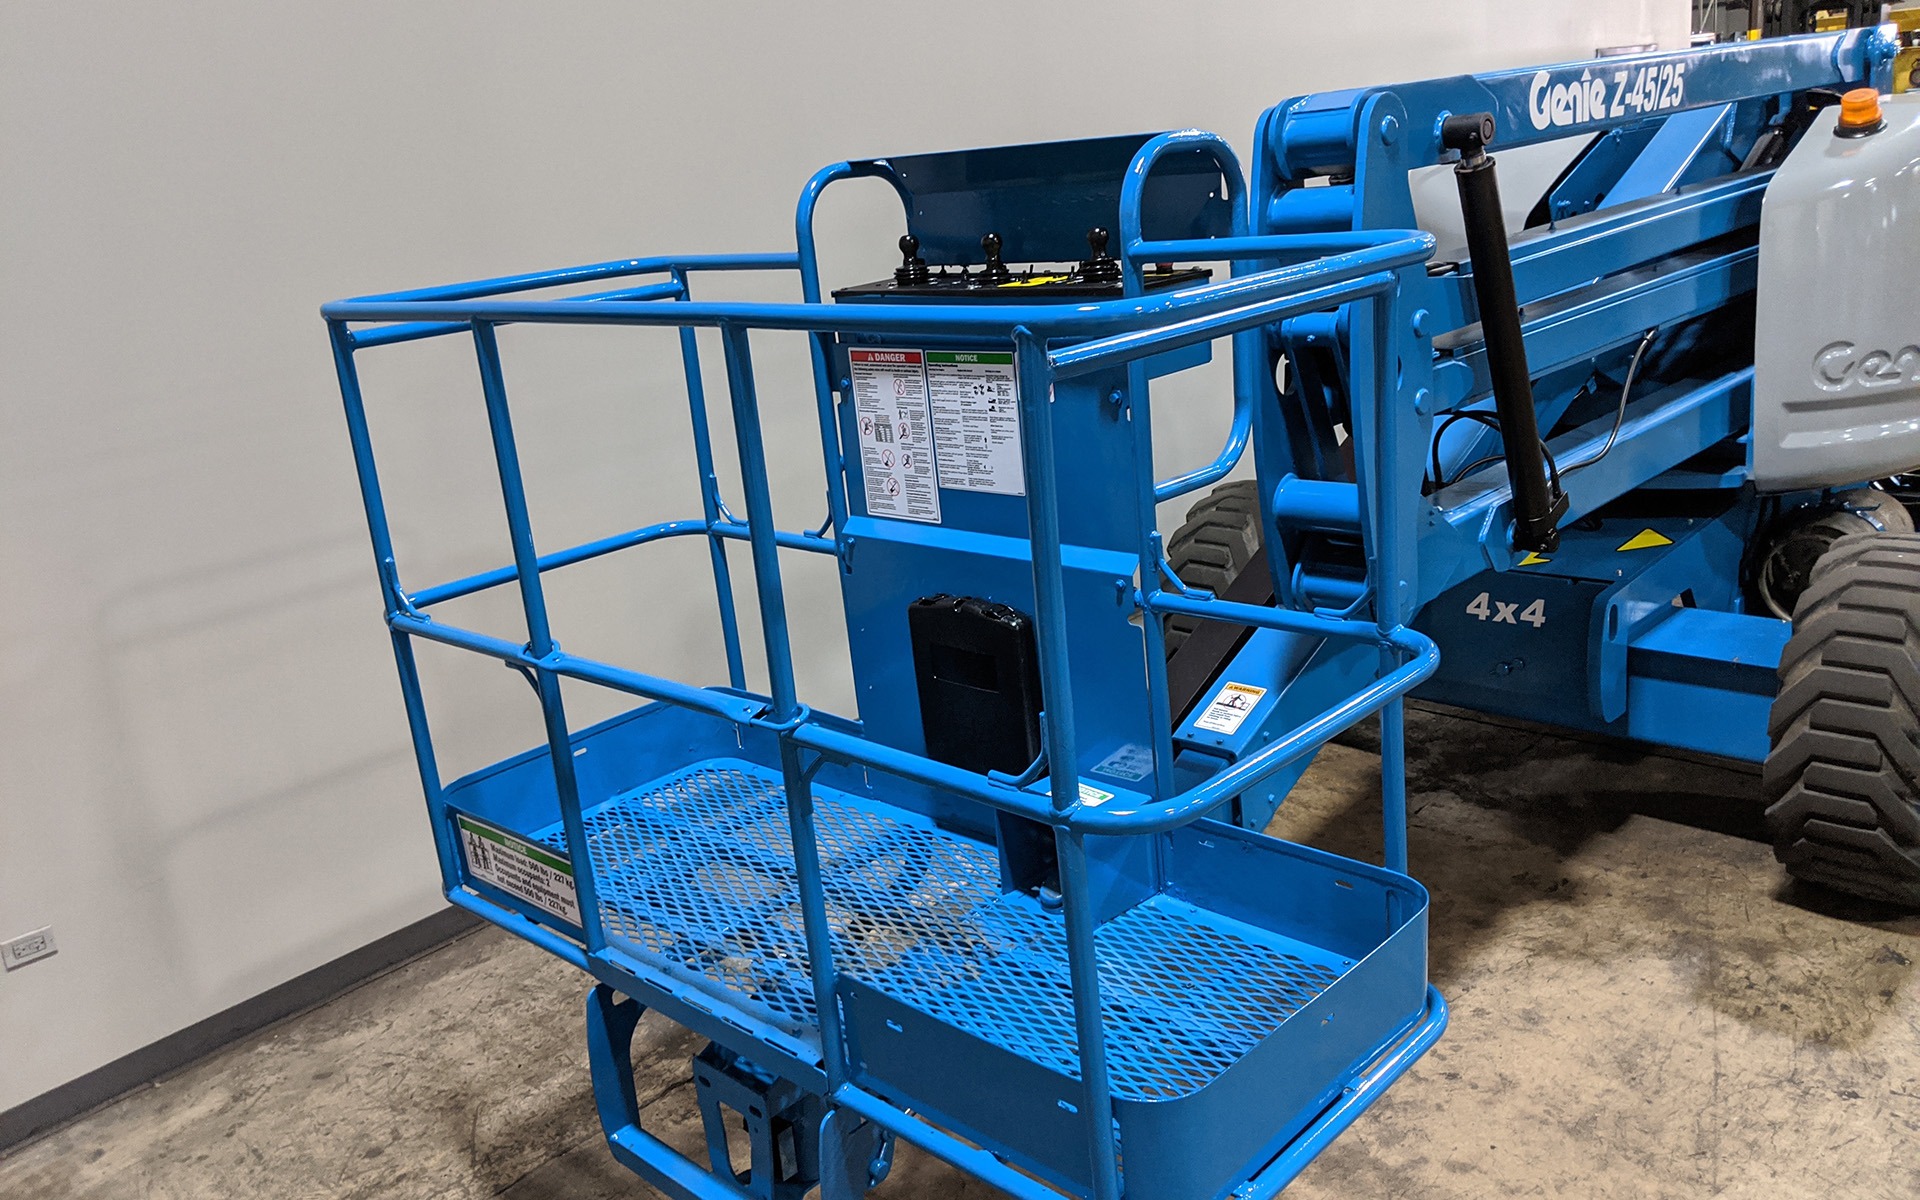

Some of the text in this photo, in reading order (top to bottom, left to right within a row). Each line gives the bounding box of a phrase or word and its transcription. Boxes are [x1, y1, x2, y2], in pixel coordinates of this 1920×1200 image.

[1529, 63, 1686, 130] Genie Z-45/25
[875, 353, 906, 362] DANGER
[955, 354, 978, 362] NOTICE
[1466, 592, 1546, 628] 4x4
[504, 838, 528, 855] NOTICE
